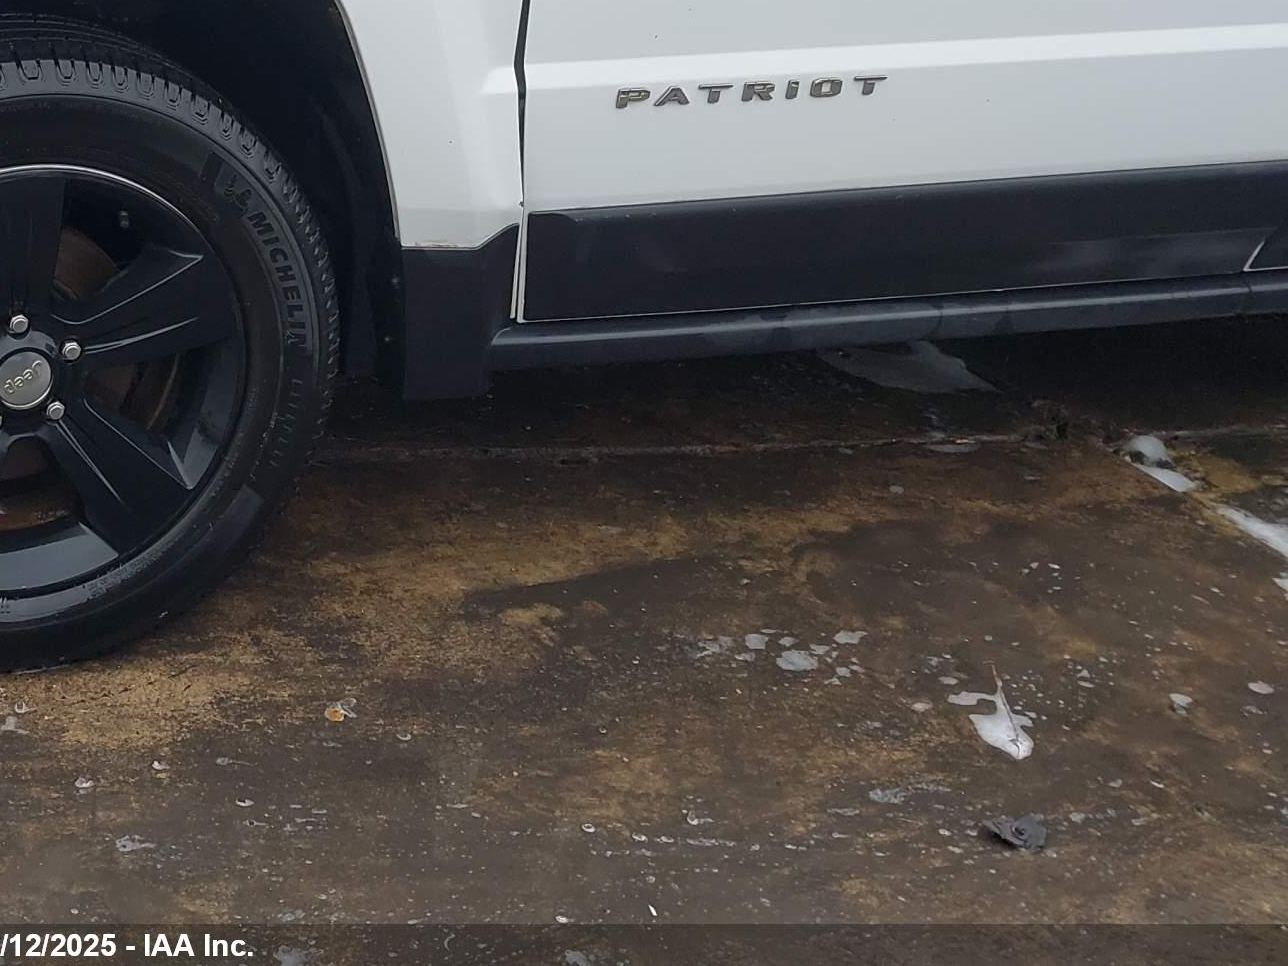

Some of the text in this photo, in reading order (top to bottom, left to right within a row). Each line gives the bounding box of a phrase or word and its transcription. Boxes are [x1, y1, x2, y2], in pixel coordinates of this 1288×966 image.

[615, 75, 888, 108] PATRIOT
[246, 211, 310, 352] MICHELIN
[4, 360, 42, 394] Jeep
